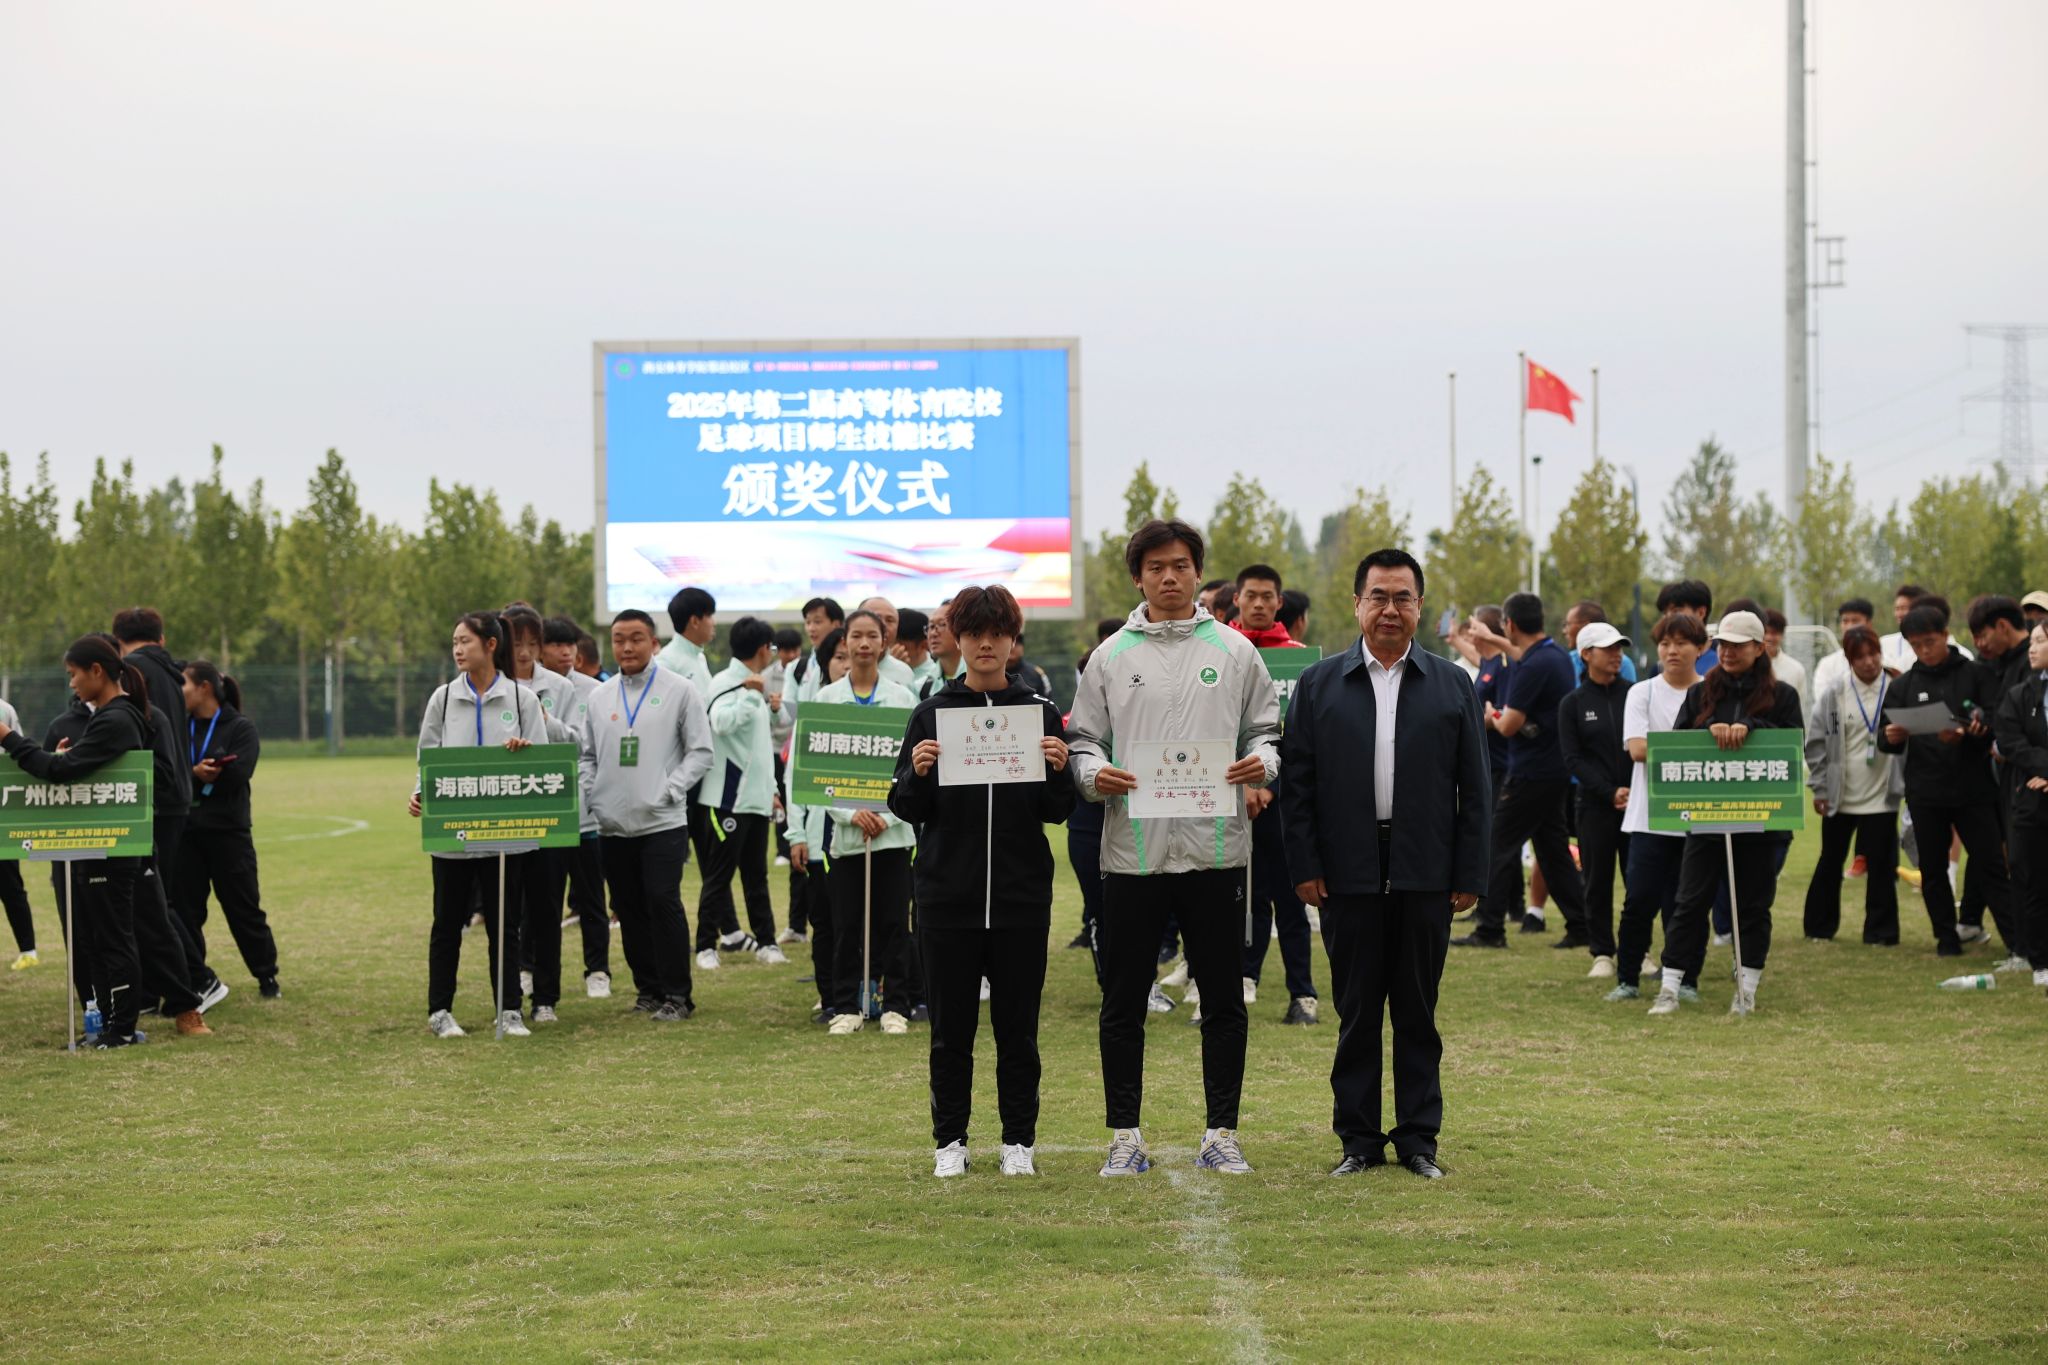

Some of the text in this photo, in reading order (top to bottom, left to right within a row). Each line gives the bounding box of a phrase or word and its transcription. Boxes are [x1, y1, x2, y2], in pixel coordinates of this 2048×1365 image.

[667, 387, 1003, 420] 2025年第二届高等体育院校
[697, 420, 975, 452] 足球项目师生技能比赛
[722, 460, 951, 517] 颁奖仪式
[966, 734, 1016, 743] 获奖证书
[964, 757, 1019, 765] 学生一等奖
[1156, 768, 1208, 776] 获奖证书
[1661, 760, 1789, 782] 南京体育学院
[2, 782, 138, 806] 广州体育学院
[435, 773, 565, 798] 海南师范大学
[1154, 790, 1210, 799] 学生一等奖
